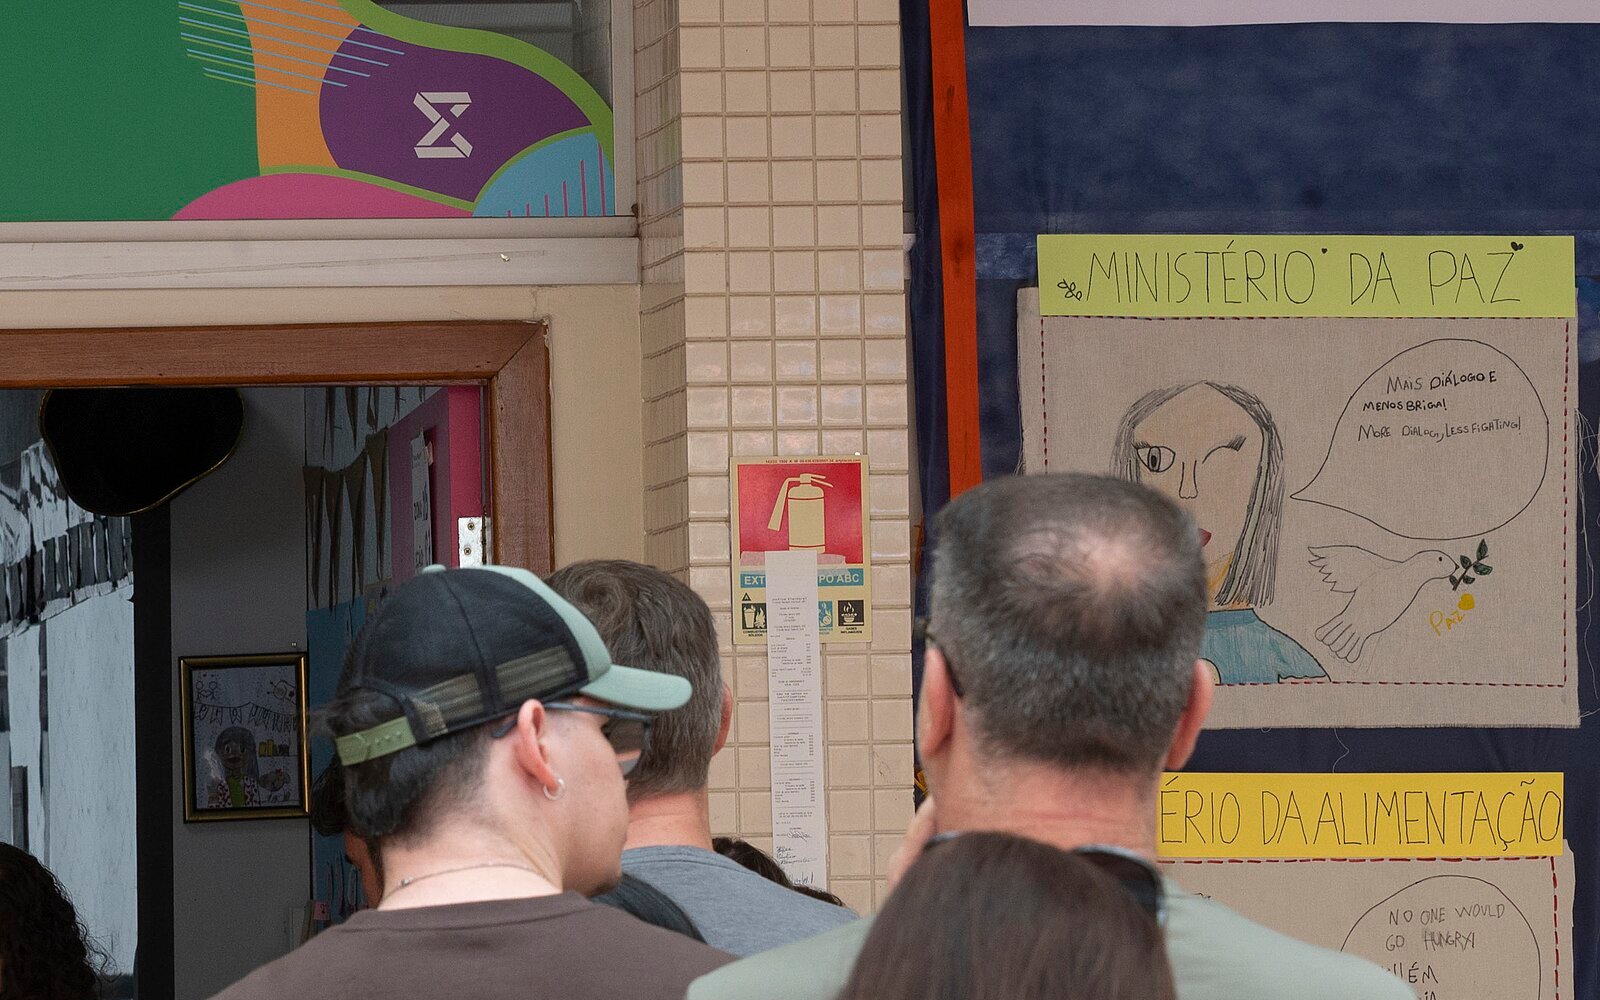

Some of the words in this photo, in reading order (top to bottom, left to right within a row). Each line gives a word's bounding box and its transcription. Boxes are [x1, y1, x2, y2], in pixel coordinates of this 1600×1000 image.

[1086, 240, 1316, 304] MINISTÉRIO
[1350, 251, 1400, 305] DA
[1428, 250, 1521, 305] PAZ
[1489, 371, 1497, 383] E
[1362, 400, 1403, 412] MENOS
[1445, 423, 1469, 437] LESS
[744, 576, 766, 585] EXT
[819, 574, 834, 583] PO
[836, 574, 860, 583] ABC
[1160, 775, 1241, 844] ÉRIO
[1262, 790, 1308, 845] DA
[1313, 778, 1562, 852] ALIMENTAÇÃO
[1389, 909, 1414, 926] NO
[1420, 907, 1446, 925] ONE
[1455, 903, 1506, 919] WOULD
[1385, 934, 1405, 952] GO
